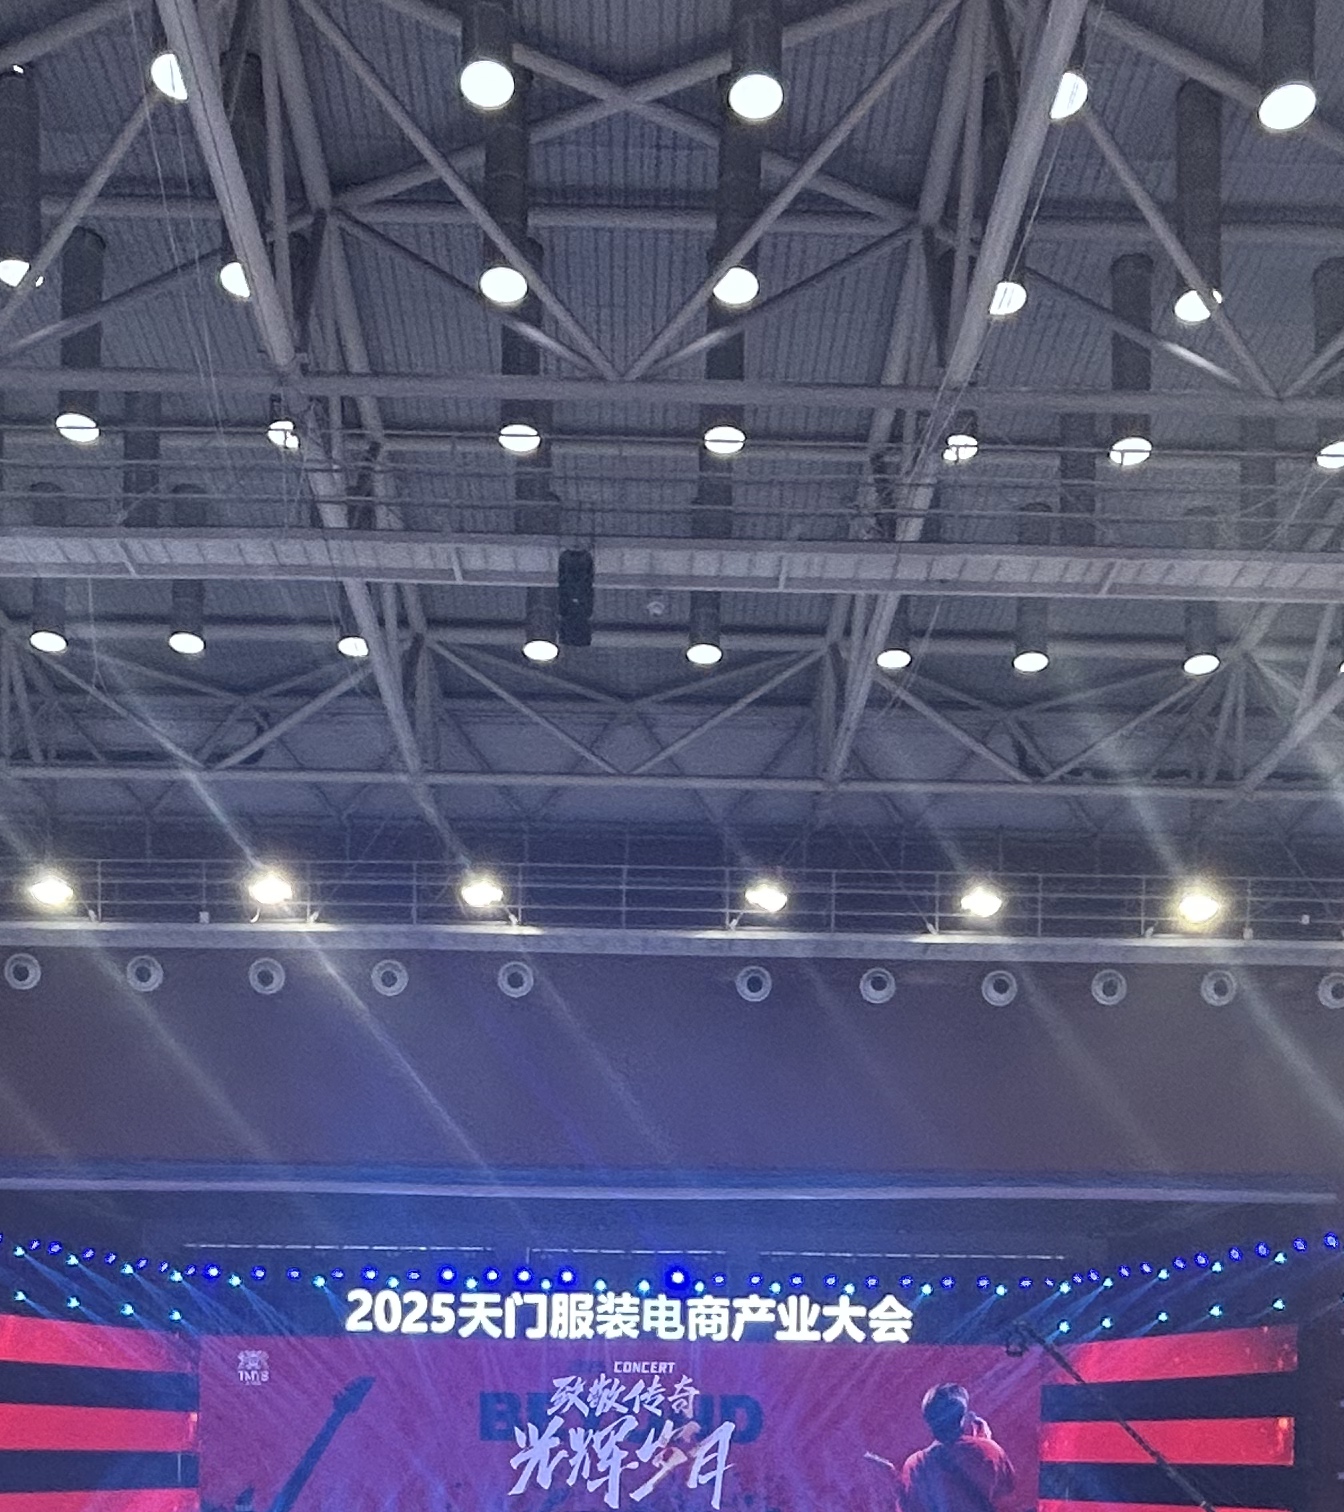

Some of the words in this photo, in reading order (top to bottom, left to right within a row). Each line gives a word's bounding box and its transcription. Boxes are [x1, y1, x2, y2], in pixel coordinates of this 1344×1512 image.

[345, 1289, 914, 1344] 2025天门服装电商产业大会
[613, 1361, 676, 1373] CONCERT
[546, 1373, 700, 1418] 致敬传奇
[508, 1415, 736, 1510] 光辉岁月
